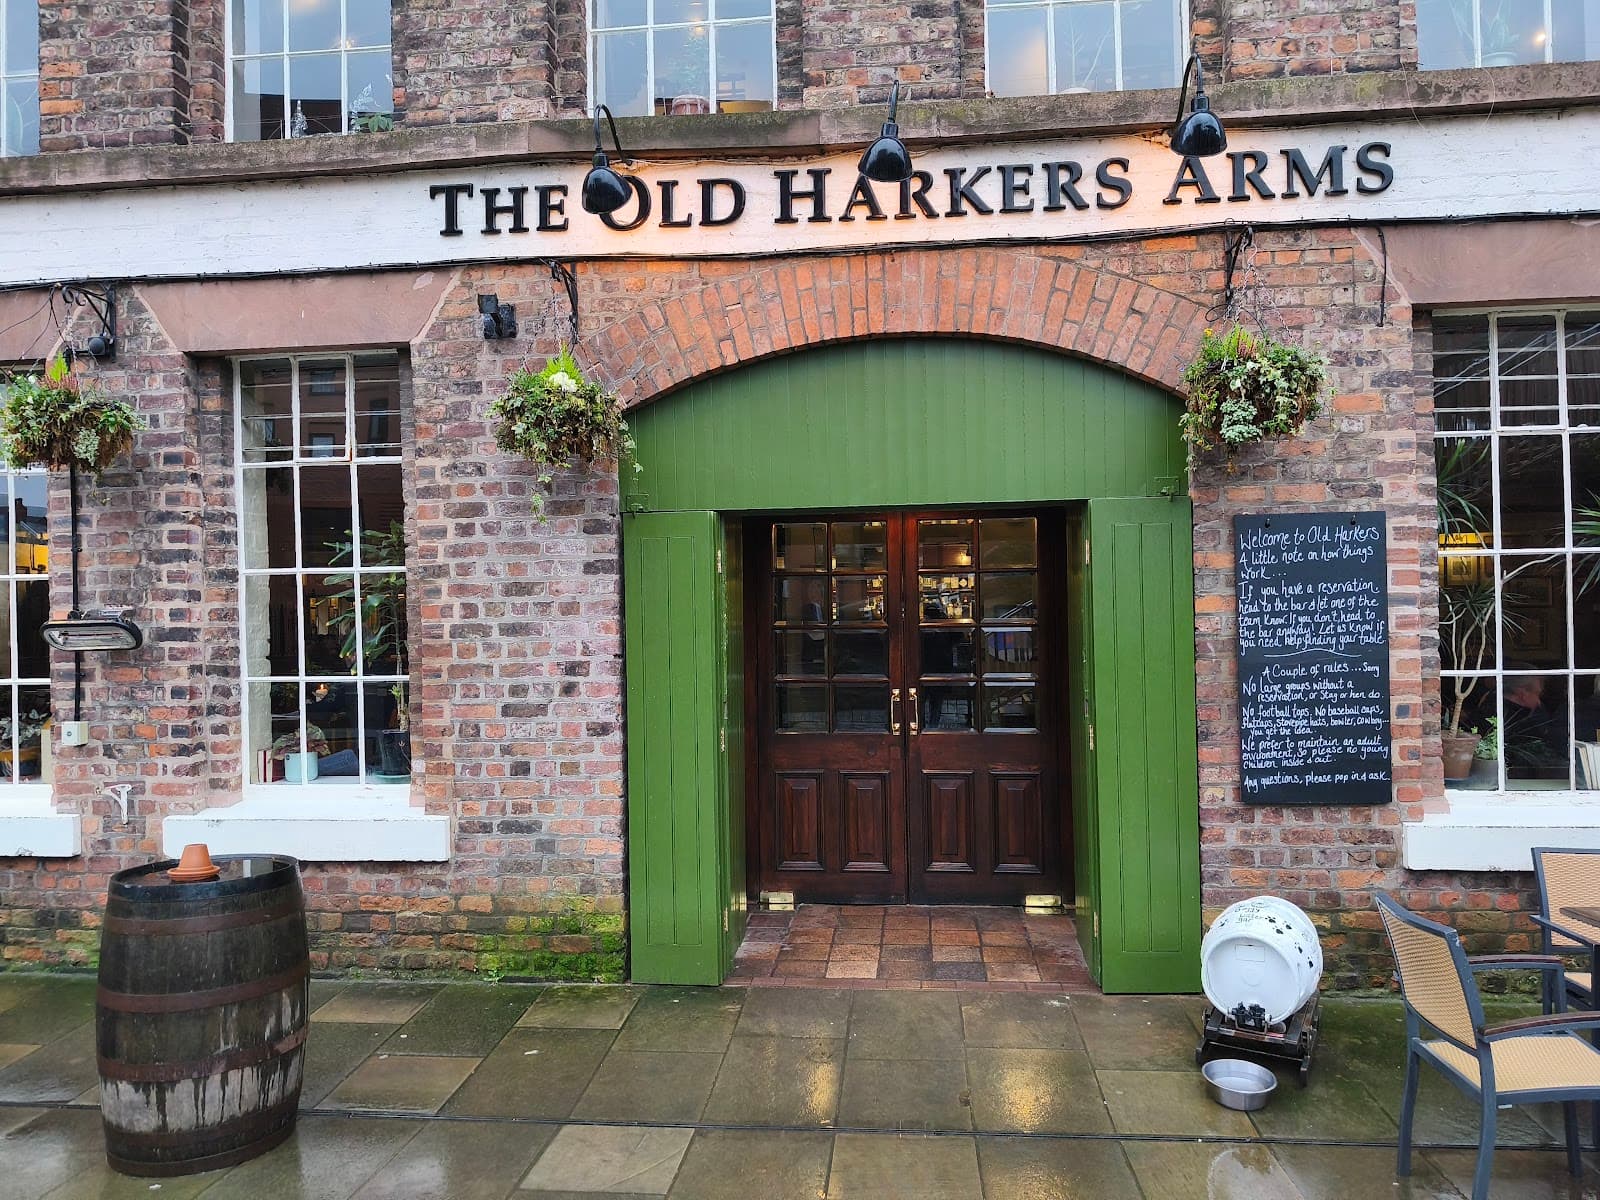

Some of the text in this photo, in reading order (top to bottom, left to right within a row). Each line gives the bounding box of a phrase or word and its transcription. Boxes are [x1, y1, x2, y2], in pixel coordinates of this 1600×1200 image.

[429, 141, 1394, 236] THE OLD HARKERS ARMS
[1240, 525, 1380, 550] Welcome to Old Harkers
[1239, 544, 1374, 570] A little note on how things
[1238, 580, 1253, 602] If
[1261, 586, 1279, 602] you
[1281, 579, 1304, 598] have
[1306, 583, 1315, 594] a
[1238, 599, 1260, 614] head
[1261, 600, 1272, 612] to
[1274, 596, 1289, 611] the
[1290, 597, 1308, 611] bar
[1317, 595, 1329, 612] let
[1330, 597, 1346, 608] one
[1347, 596, 1357, 611] of
[1358, 593, 1379, 607] the
[1238, 613, 1262, 627] team
[1289, 612, 1297, 628] If
[1297, 615, 1313, 626] you
[1340, 608, 1363, 622] head
[1365, 607, 1376, 620] to
[1238, 625, 1256, 639] the
[1258, 625, 1274, 638] bar
[1318, 622, 1335, 635] Let
[1336, 623, 1347, 633] us
[1376, 619, 1385, 635] if
[1239, 637, 1257, 656] you
[1258, 635, 1283, 648] need
[1284, 634, 1302, 650] help
[1301, 633, 1337, 652] finding
[1338, 633, 1358, 651] your
[1261, 665, 1273, 684] A
[1272, 663, 1308, 680] Couple
[1309, 663, 1320, 678] of
[1242, 675, 1257, 696] No
[1285, 682, 1311, 693] groups
[1312, 677, 1345, 691] without
[1346, 680, 1355, 689] a
[1257, 690, 1308, 702] reservation,
[1308, 691, 1317, 700] or
[1339, 691, 1348, 699] or
[1349, 689, 1367, 699] hen
[1242, 702, 1255, 719] No
[1257, 703, 1291, 720] football
[1314, 703, 1326, 717] No
[1328, 703, 1361, 717] baseball
[1361, 704, 1384, 716] caps,
[1309, 716, 1329, 727] hats,
[1330, 716, 1356, 727] bowler,
[1241, 734, 1382, 754] We prefer to maintain an adult
[1250, 726, 1265, 741] you
[1265, 727, 1278, 740] get
[1279, 726, 1292, 736] the
[1281, 757, 1305, 767] inside
[1311, 746, 1343, 758] please
[1346, 746, 1358, 754] no
[1360, 745, 1389, 760] young
[1243, 775, 1259, 793] Any
[1260, 771, 1303, 790] questions,
[1305, 770, 1333, 787] please
[1334, 773, 1349, 784] pop
[1351, 770, 1360, 781] in
